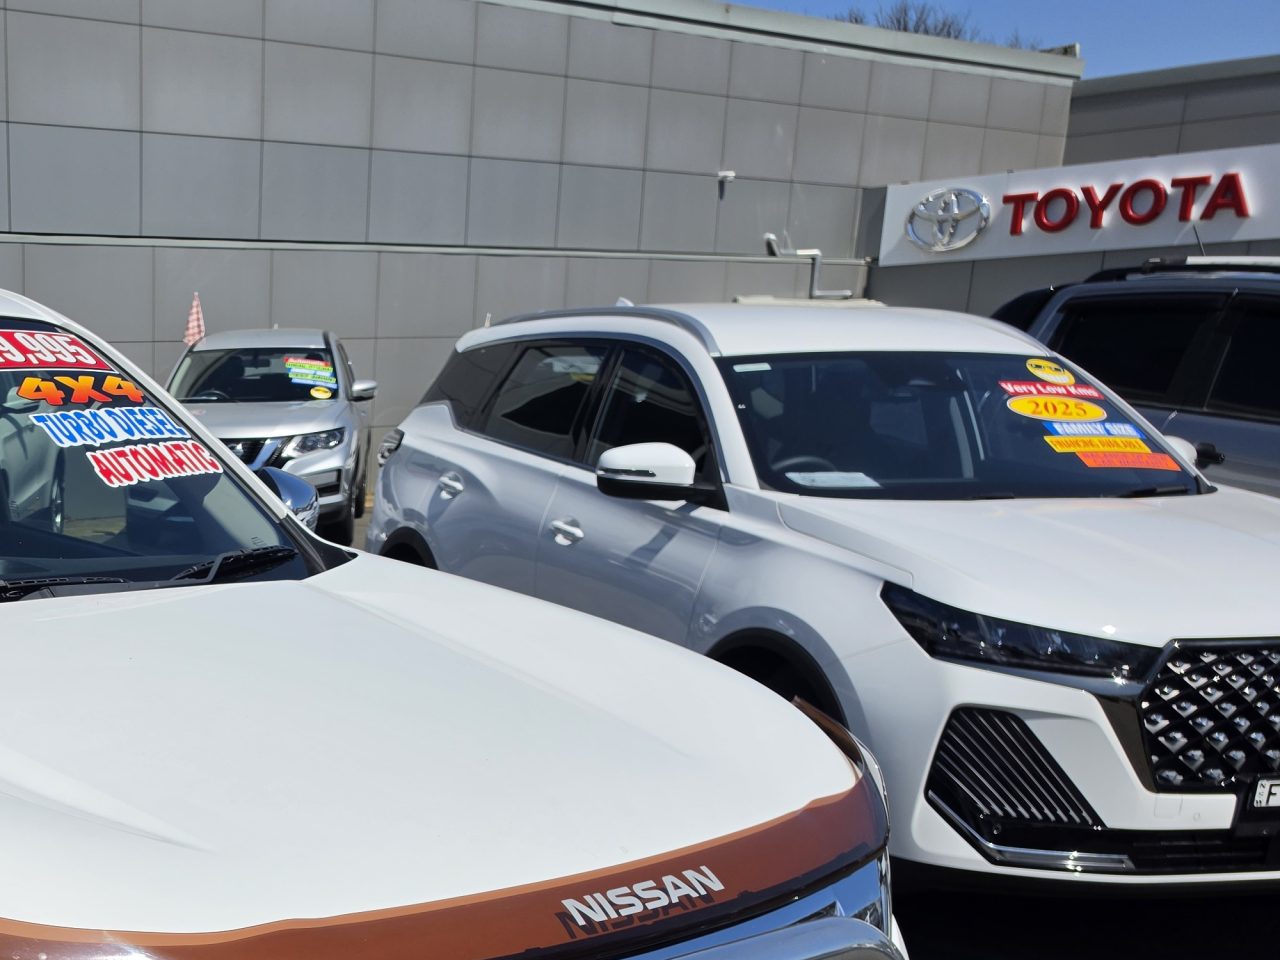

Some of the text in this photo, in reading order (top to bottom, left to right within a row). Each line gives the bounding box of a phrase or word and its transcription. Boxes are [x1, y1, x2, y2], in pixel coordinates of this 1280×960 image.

[1003, 172, 1250, 236] TOYOTA
[1000, 382, 1100, 397] Very Low Kms
[1027, 400, 1087, 417] 2025
[33, 407, 191, 446] TURBO DIESEL
[88, 441, 222, 485] AUTOMATIC
[561, 865, 725, 926] NISSAN
